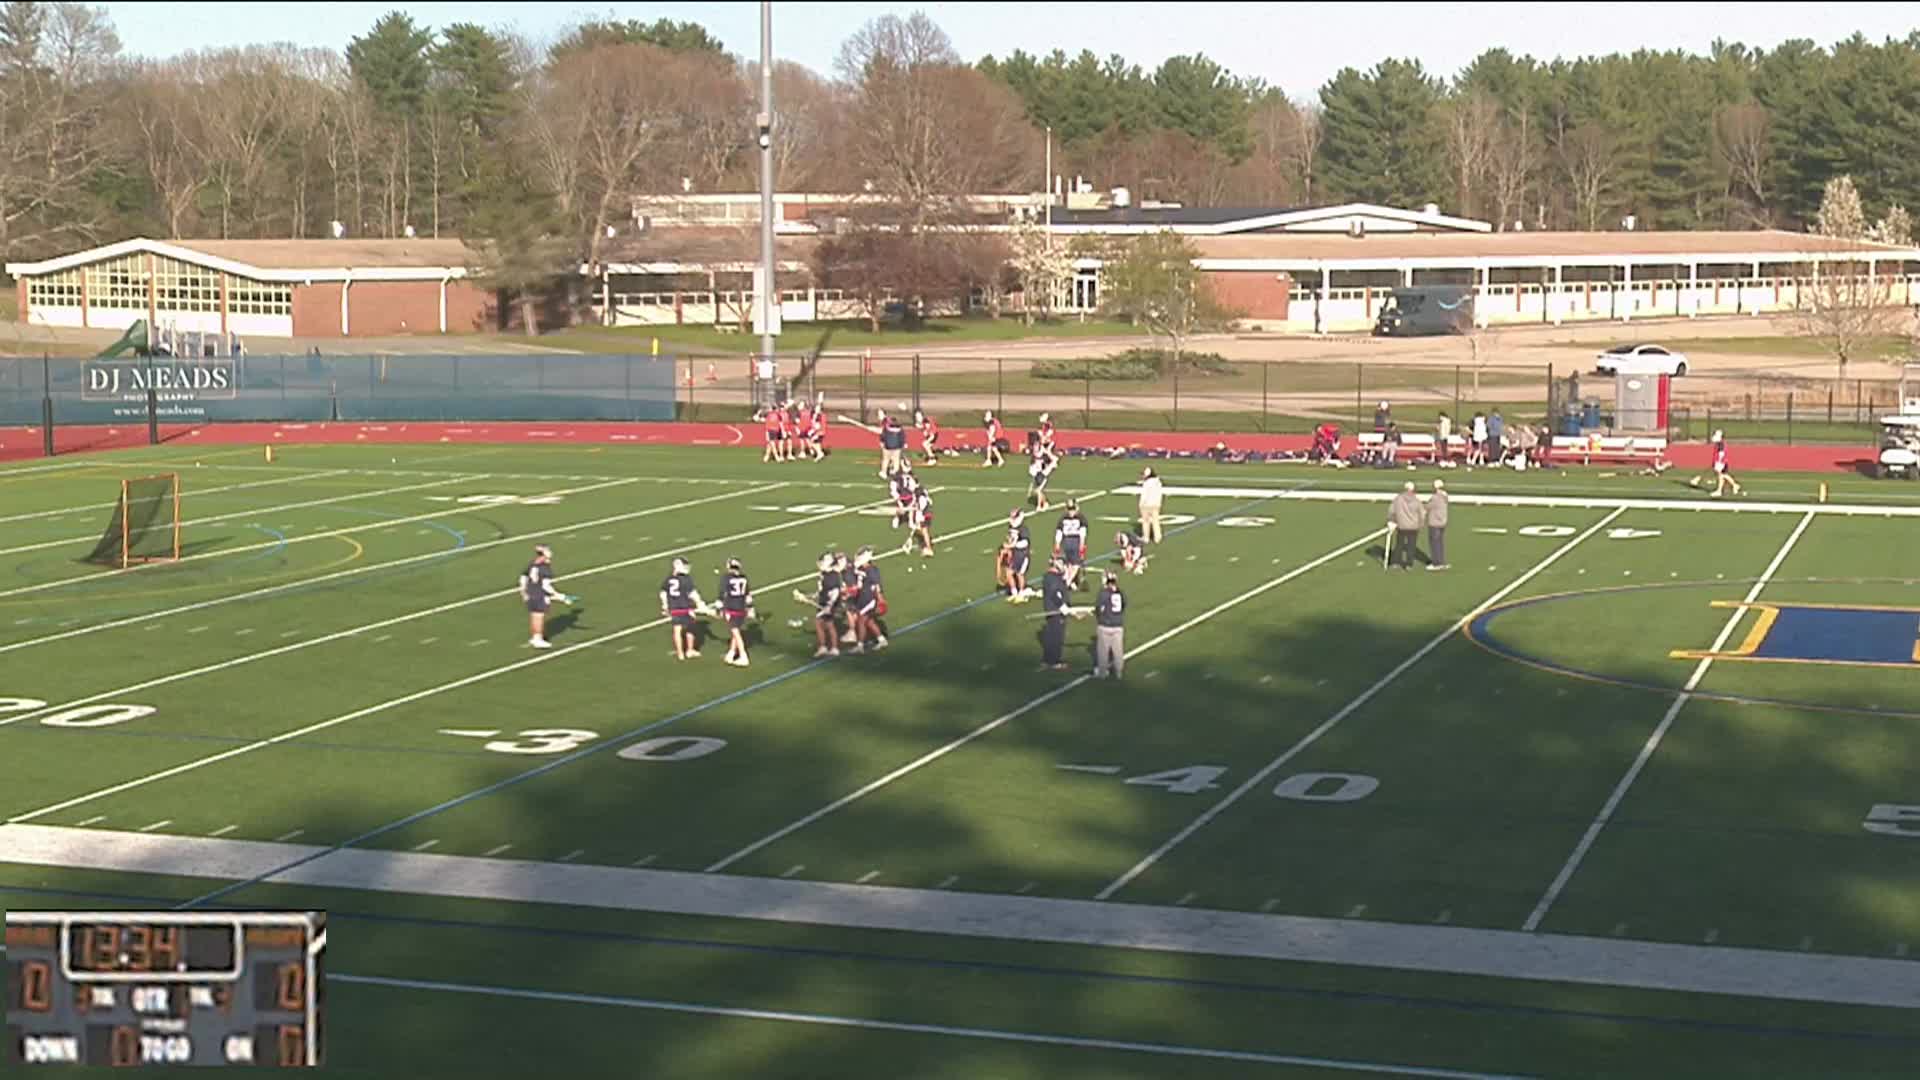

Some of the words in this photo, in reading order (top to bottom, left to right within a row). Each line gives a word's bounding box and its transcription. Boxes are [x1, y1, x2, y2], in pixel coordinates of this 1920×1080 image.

[90, 368, 120, 393] DJ
[131, 367, 228, 389] MEADS
[113, 404, 205, 415] www.dmeads.com
[668, 579, 681, 596] 2
[729, 578, 747, 596] 37
